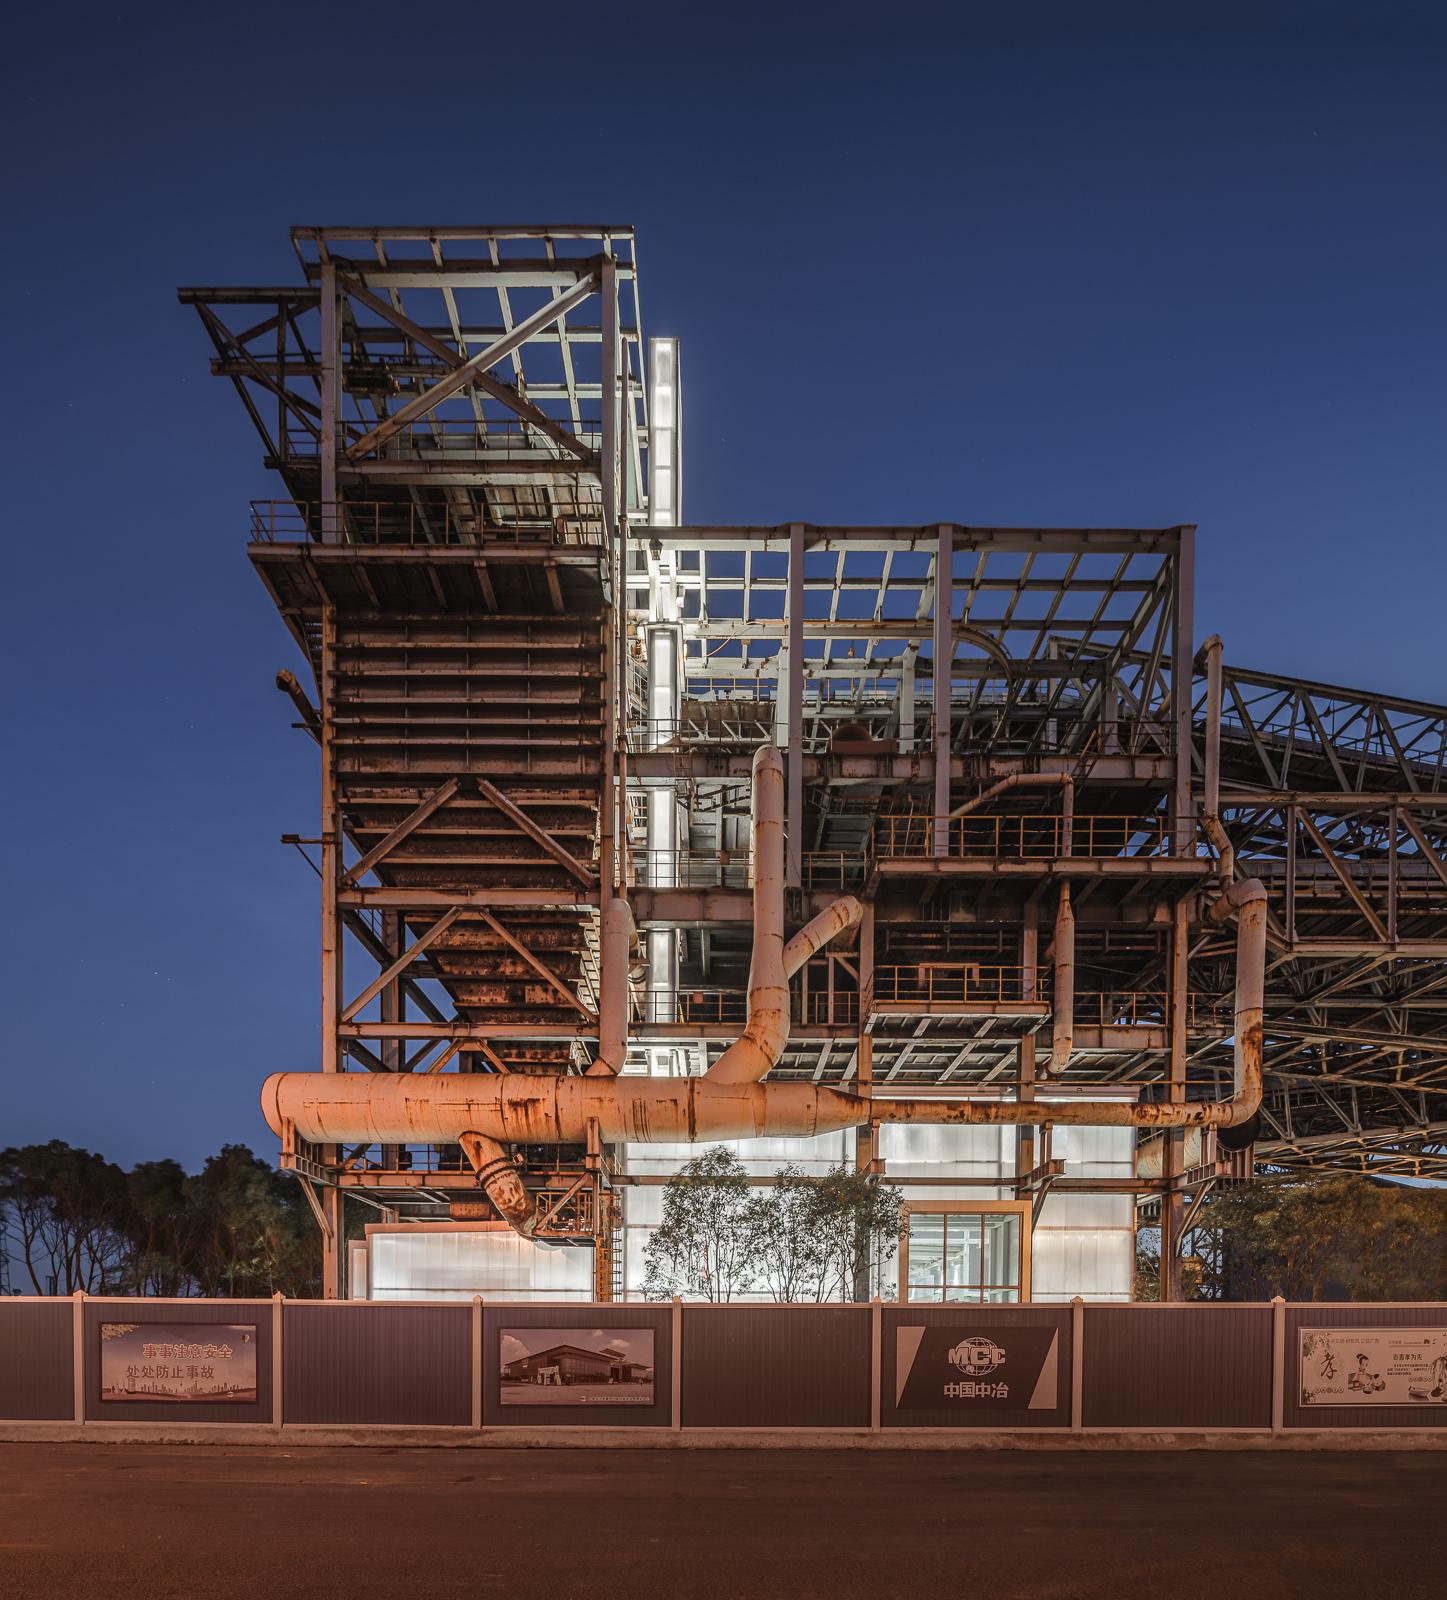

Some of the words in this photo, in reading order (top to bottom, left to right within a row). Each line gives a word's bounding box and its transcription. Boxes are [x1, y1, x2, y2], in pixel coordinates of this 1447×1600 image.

[143, 1344, 233, 1359] 事事注意安全
[948, 1347, 1006, 1365] MCC
[126, 1365, 215, 1379] 处处防止事故
[943, 1381, 1009, 1398] 中国中冶
